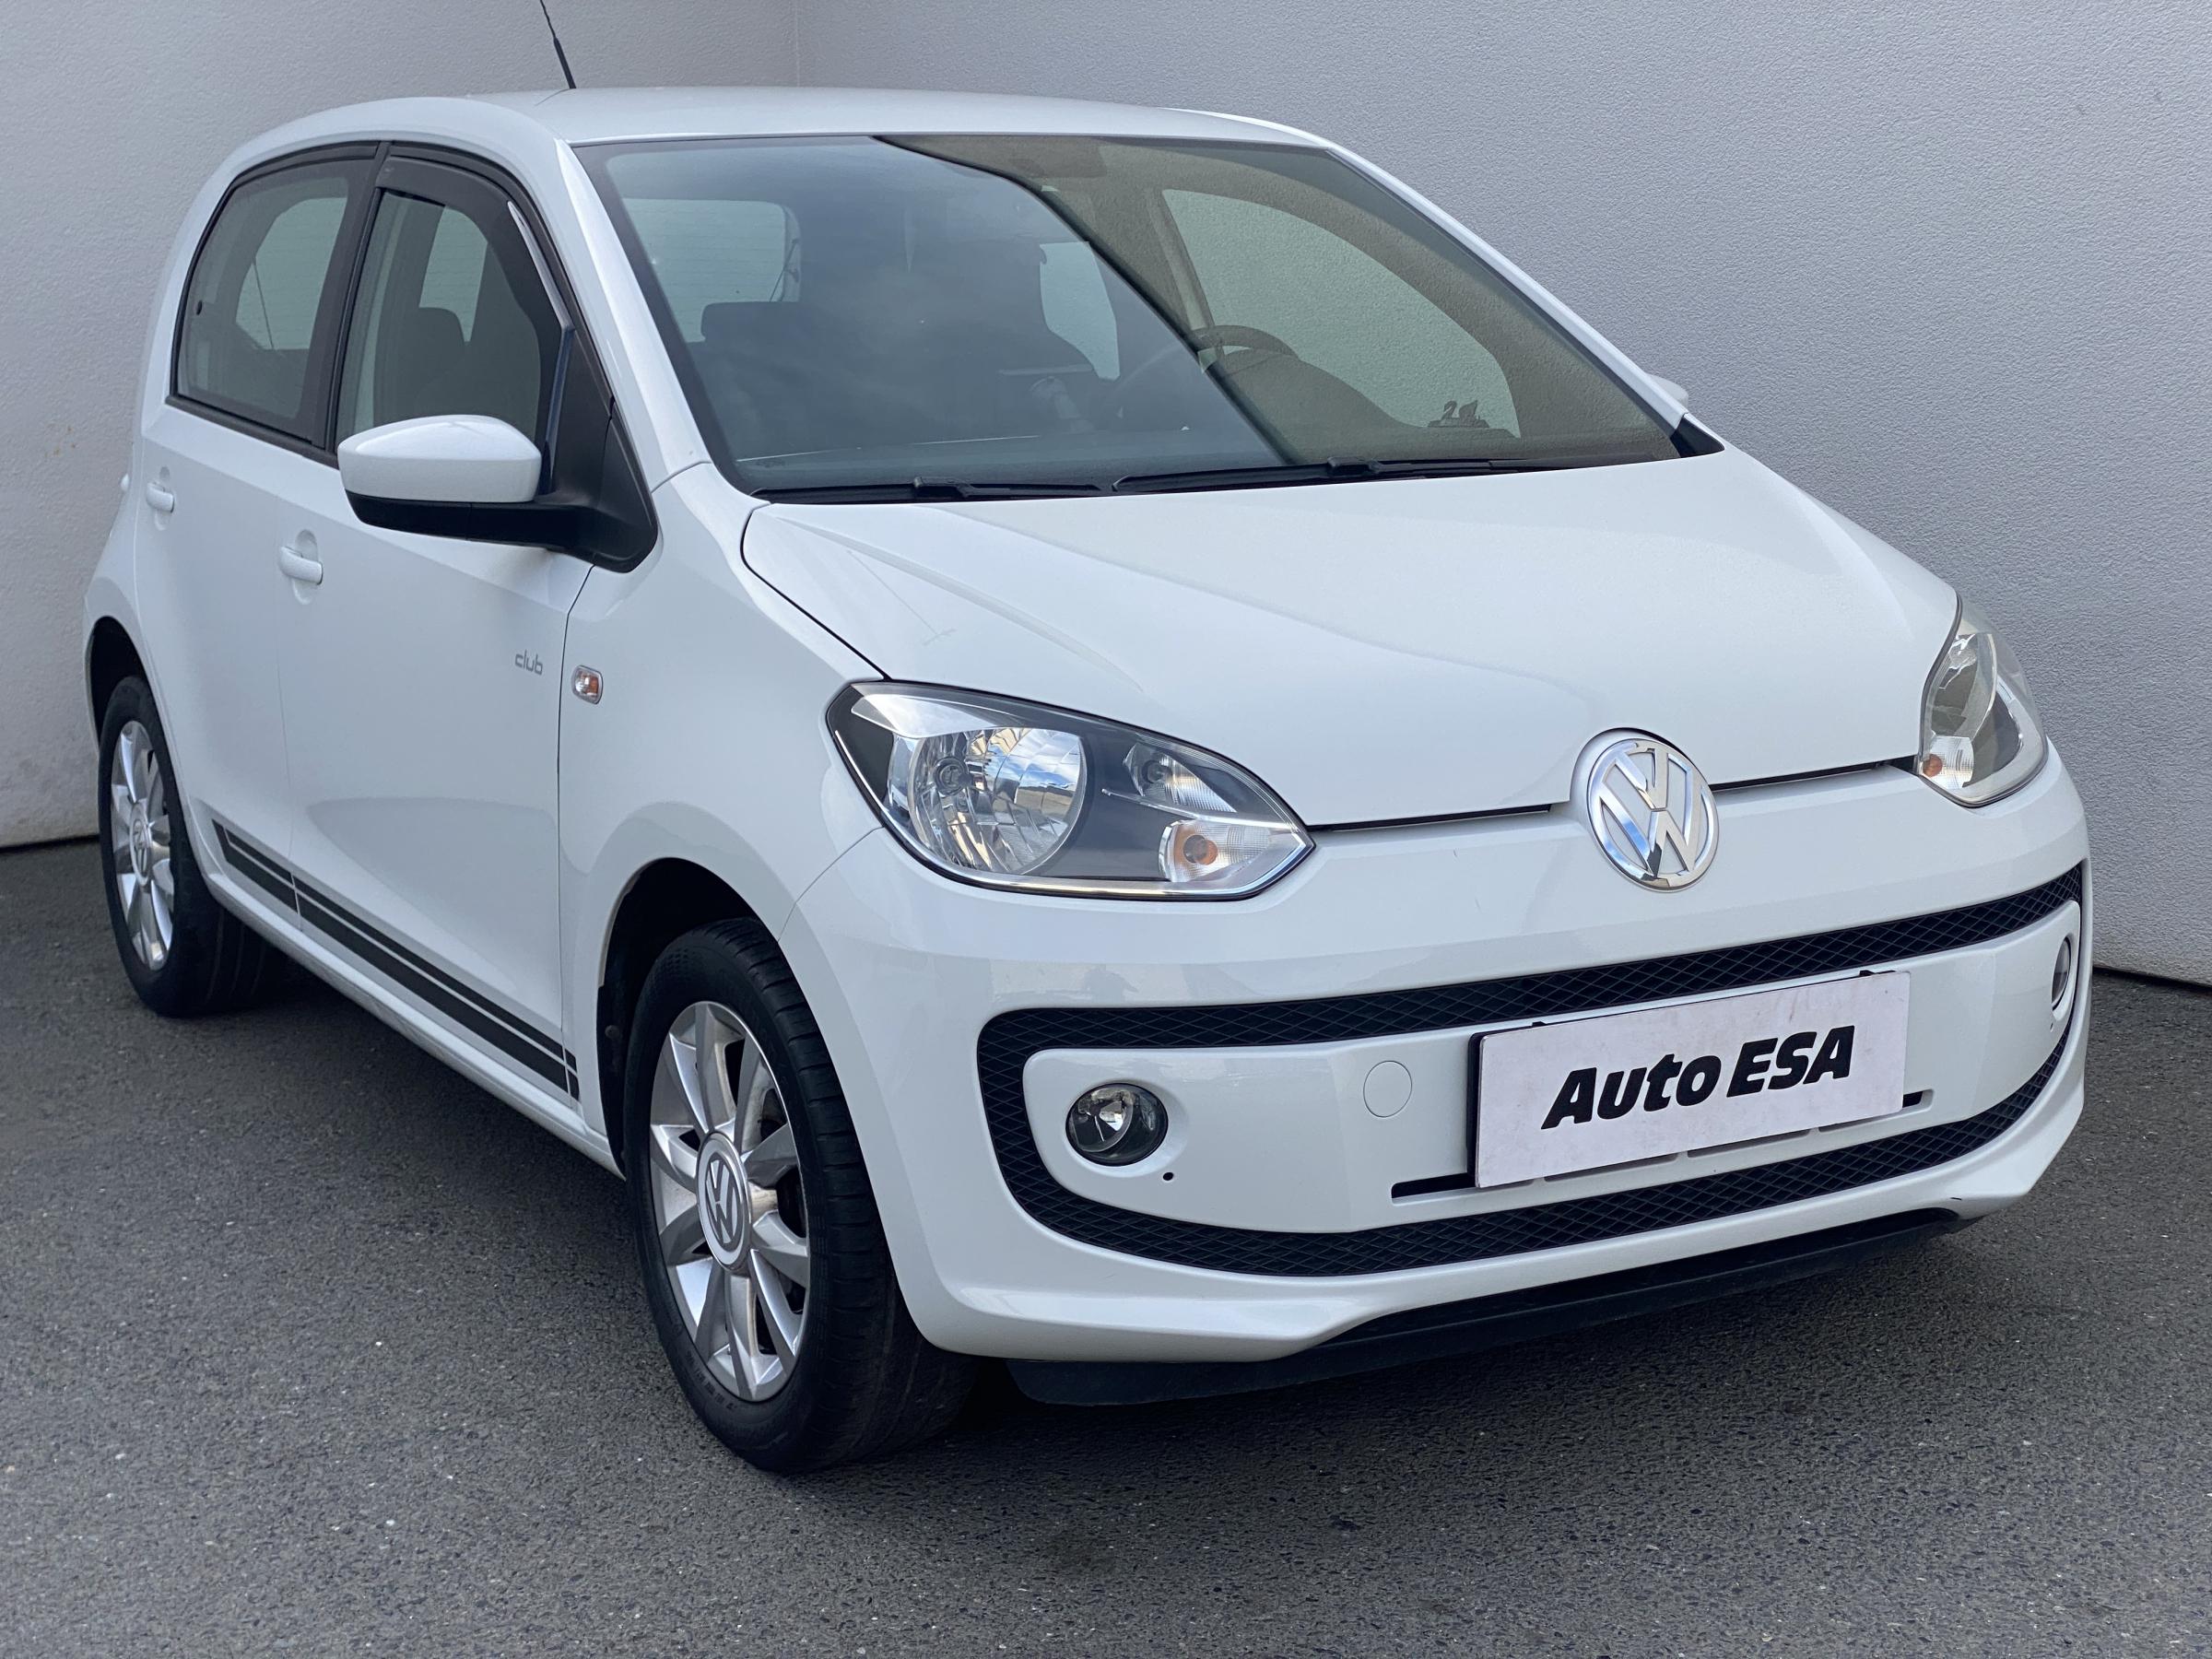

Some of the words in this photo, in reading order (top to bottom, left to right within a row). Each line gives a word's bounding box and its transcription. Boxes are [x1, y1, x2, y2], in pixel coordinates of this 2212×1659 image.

[514, 649, 544, 676] club
[1587, 738, 1719, 891] VW
[1541, 1053, 1721, 1130] Auto
[1726, 1025, 1855, 1098] ESA
